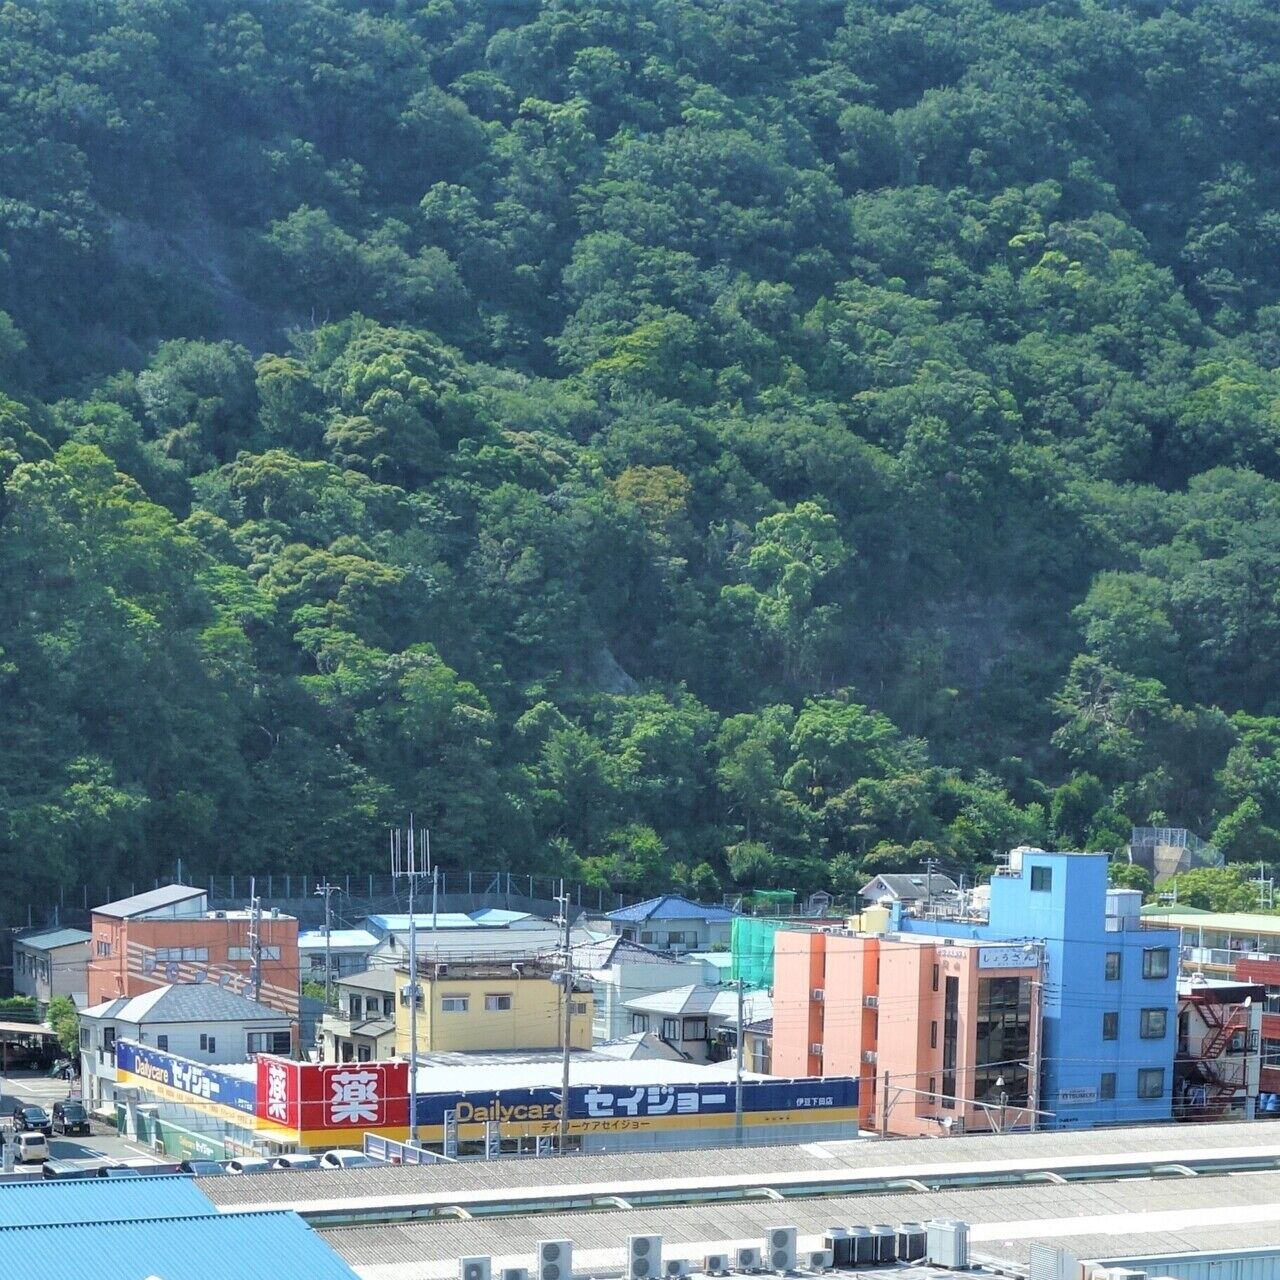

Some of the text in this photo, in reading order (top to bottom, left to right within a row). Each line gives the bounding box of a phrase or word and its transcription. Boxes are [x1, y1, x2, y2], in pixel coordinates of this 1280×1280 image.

[268, 1064, 286, 1120] 薬
[331, 1071, 378, 1123] 薬
[584, 1087, 726, 1117] セイジョー
